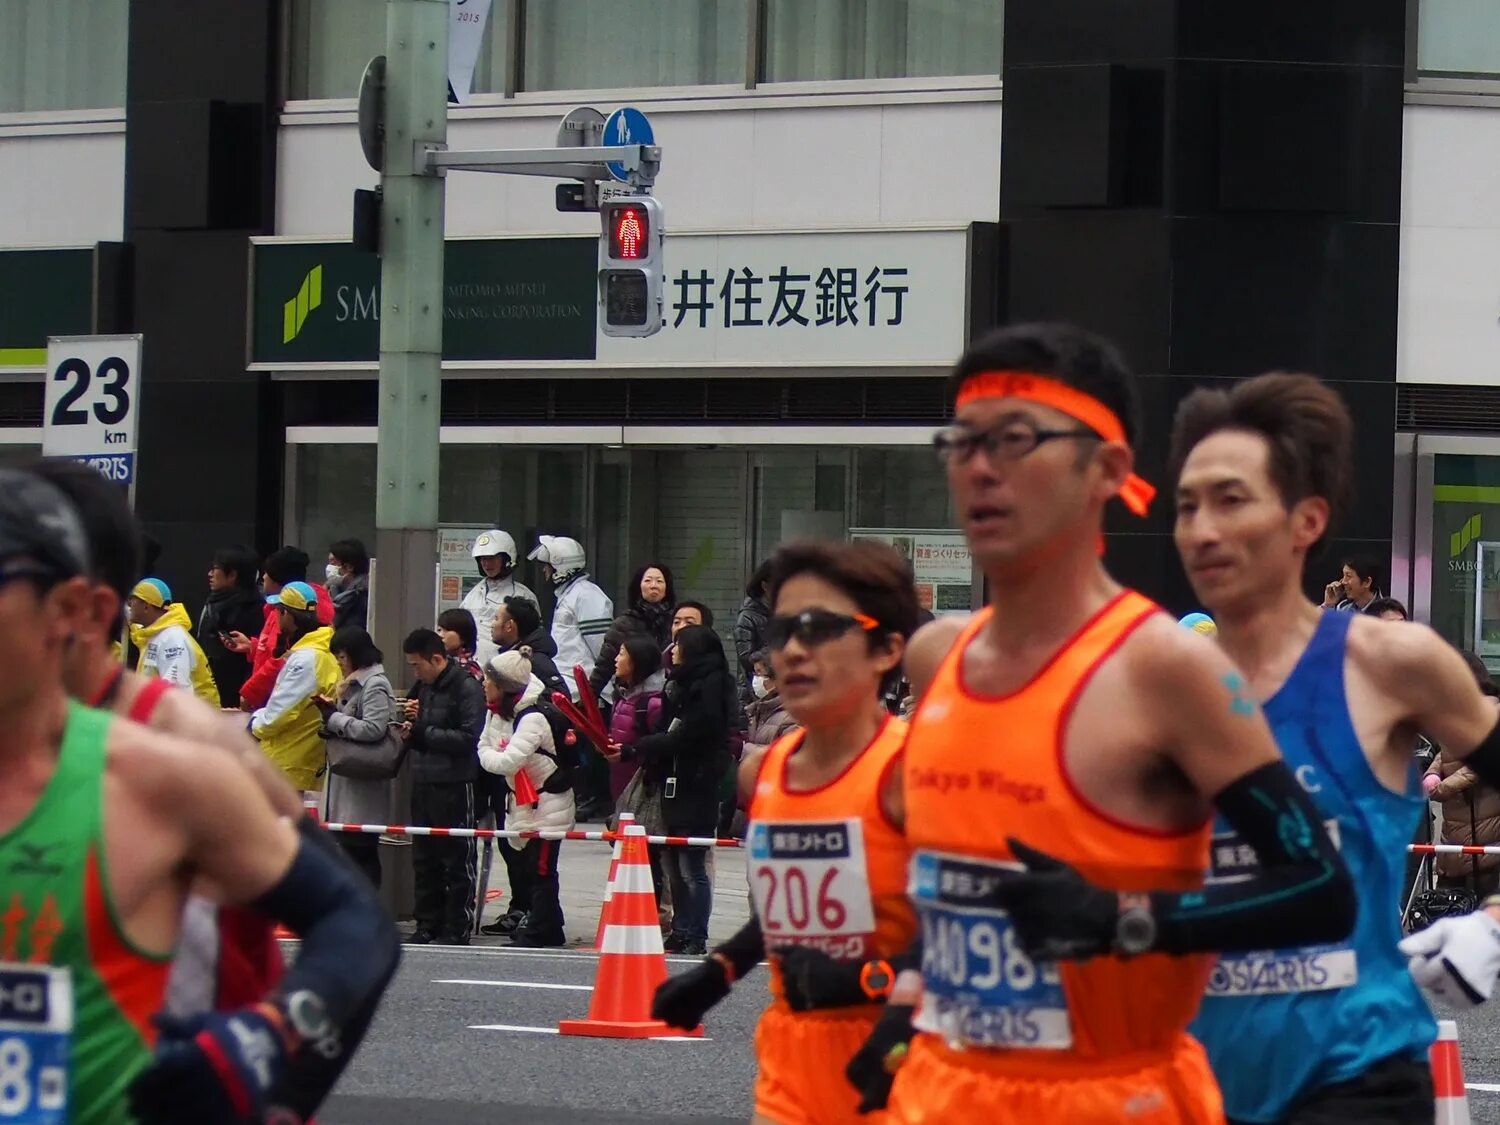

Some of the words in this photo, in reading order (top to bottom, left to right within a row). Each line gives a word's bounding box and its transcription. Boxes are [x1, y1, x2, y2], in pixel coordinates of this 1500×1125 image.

[457, 13, 480, 23] 2015
[449, 284, 499, 296] MITOMO
[662, 266, 909, 328] 井住友銀行
[336, 285, 380, 322] SM
[52, 357, 130, 426] 23
[104, 430, 127, 444] km
[1448, 560, 1482, 571] SMBC
[757, 866, 847, 931] 206
